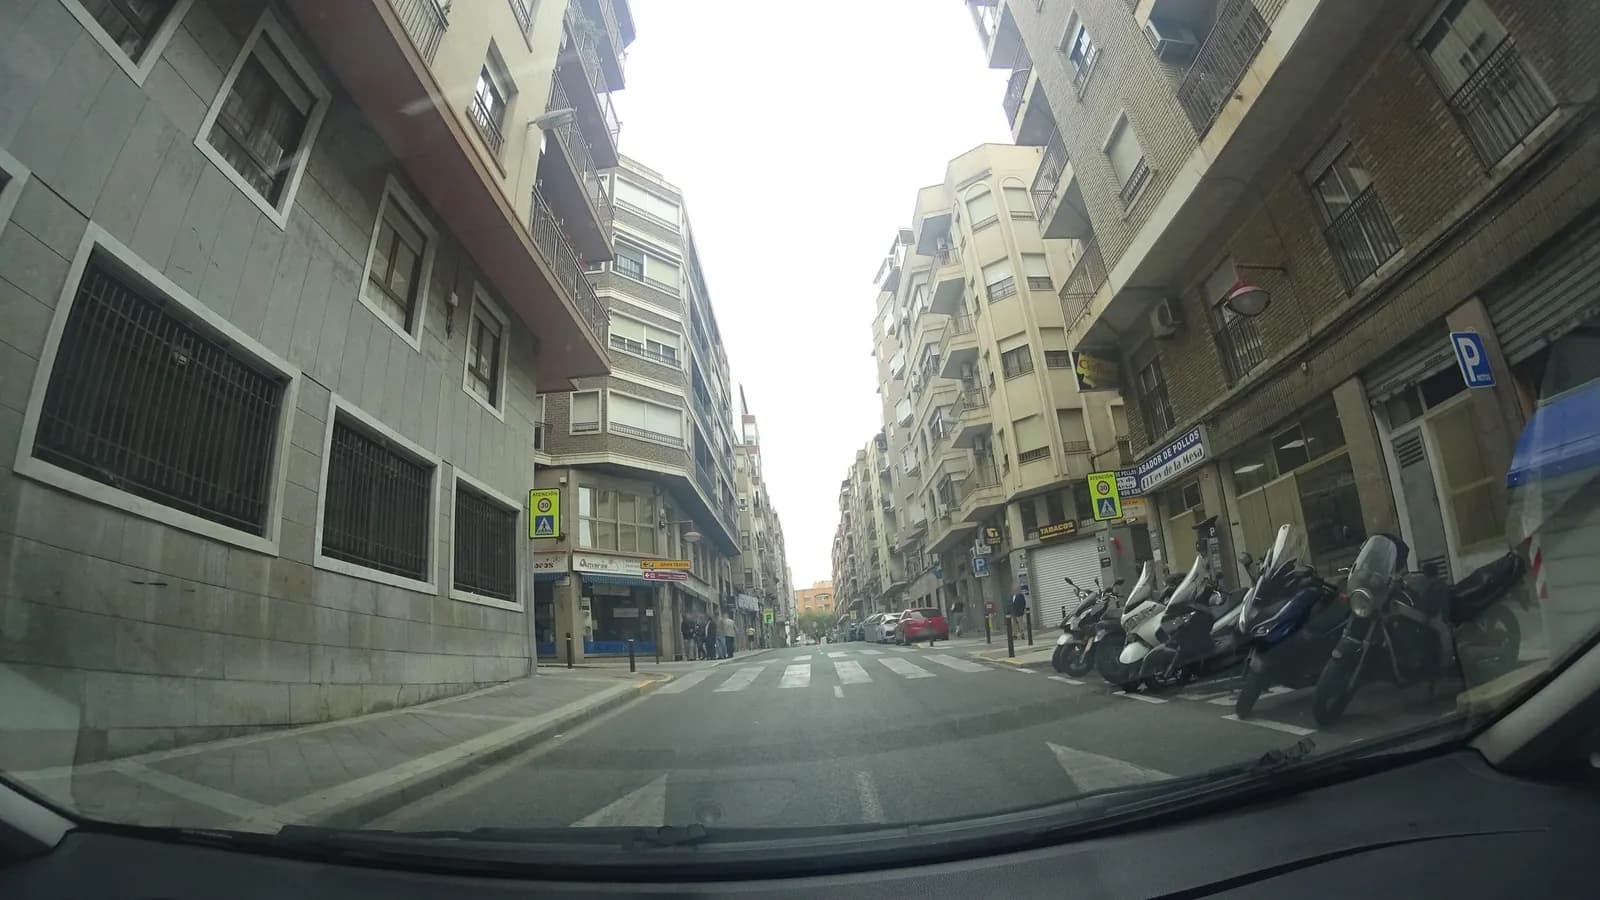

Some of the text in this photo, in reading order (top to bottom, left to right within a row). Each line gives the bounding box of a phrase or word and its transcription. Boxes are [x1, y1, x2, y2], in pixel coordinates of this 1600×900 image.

[1457, 337, 1480, 382] P
[1138, 430, 1200, 475] ASADOR DE POLLOS
[1163, 465, 1173, 476] de
[1174, 460, 1182, 471] la
[1183, 447, 1204, 464] Mesa
[1040, 520, 1073, 534] TABACOS
[1209, 527, 1216, 537] P
[976, 558, 985, 570] P
